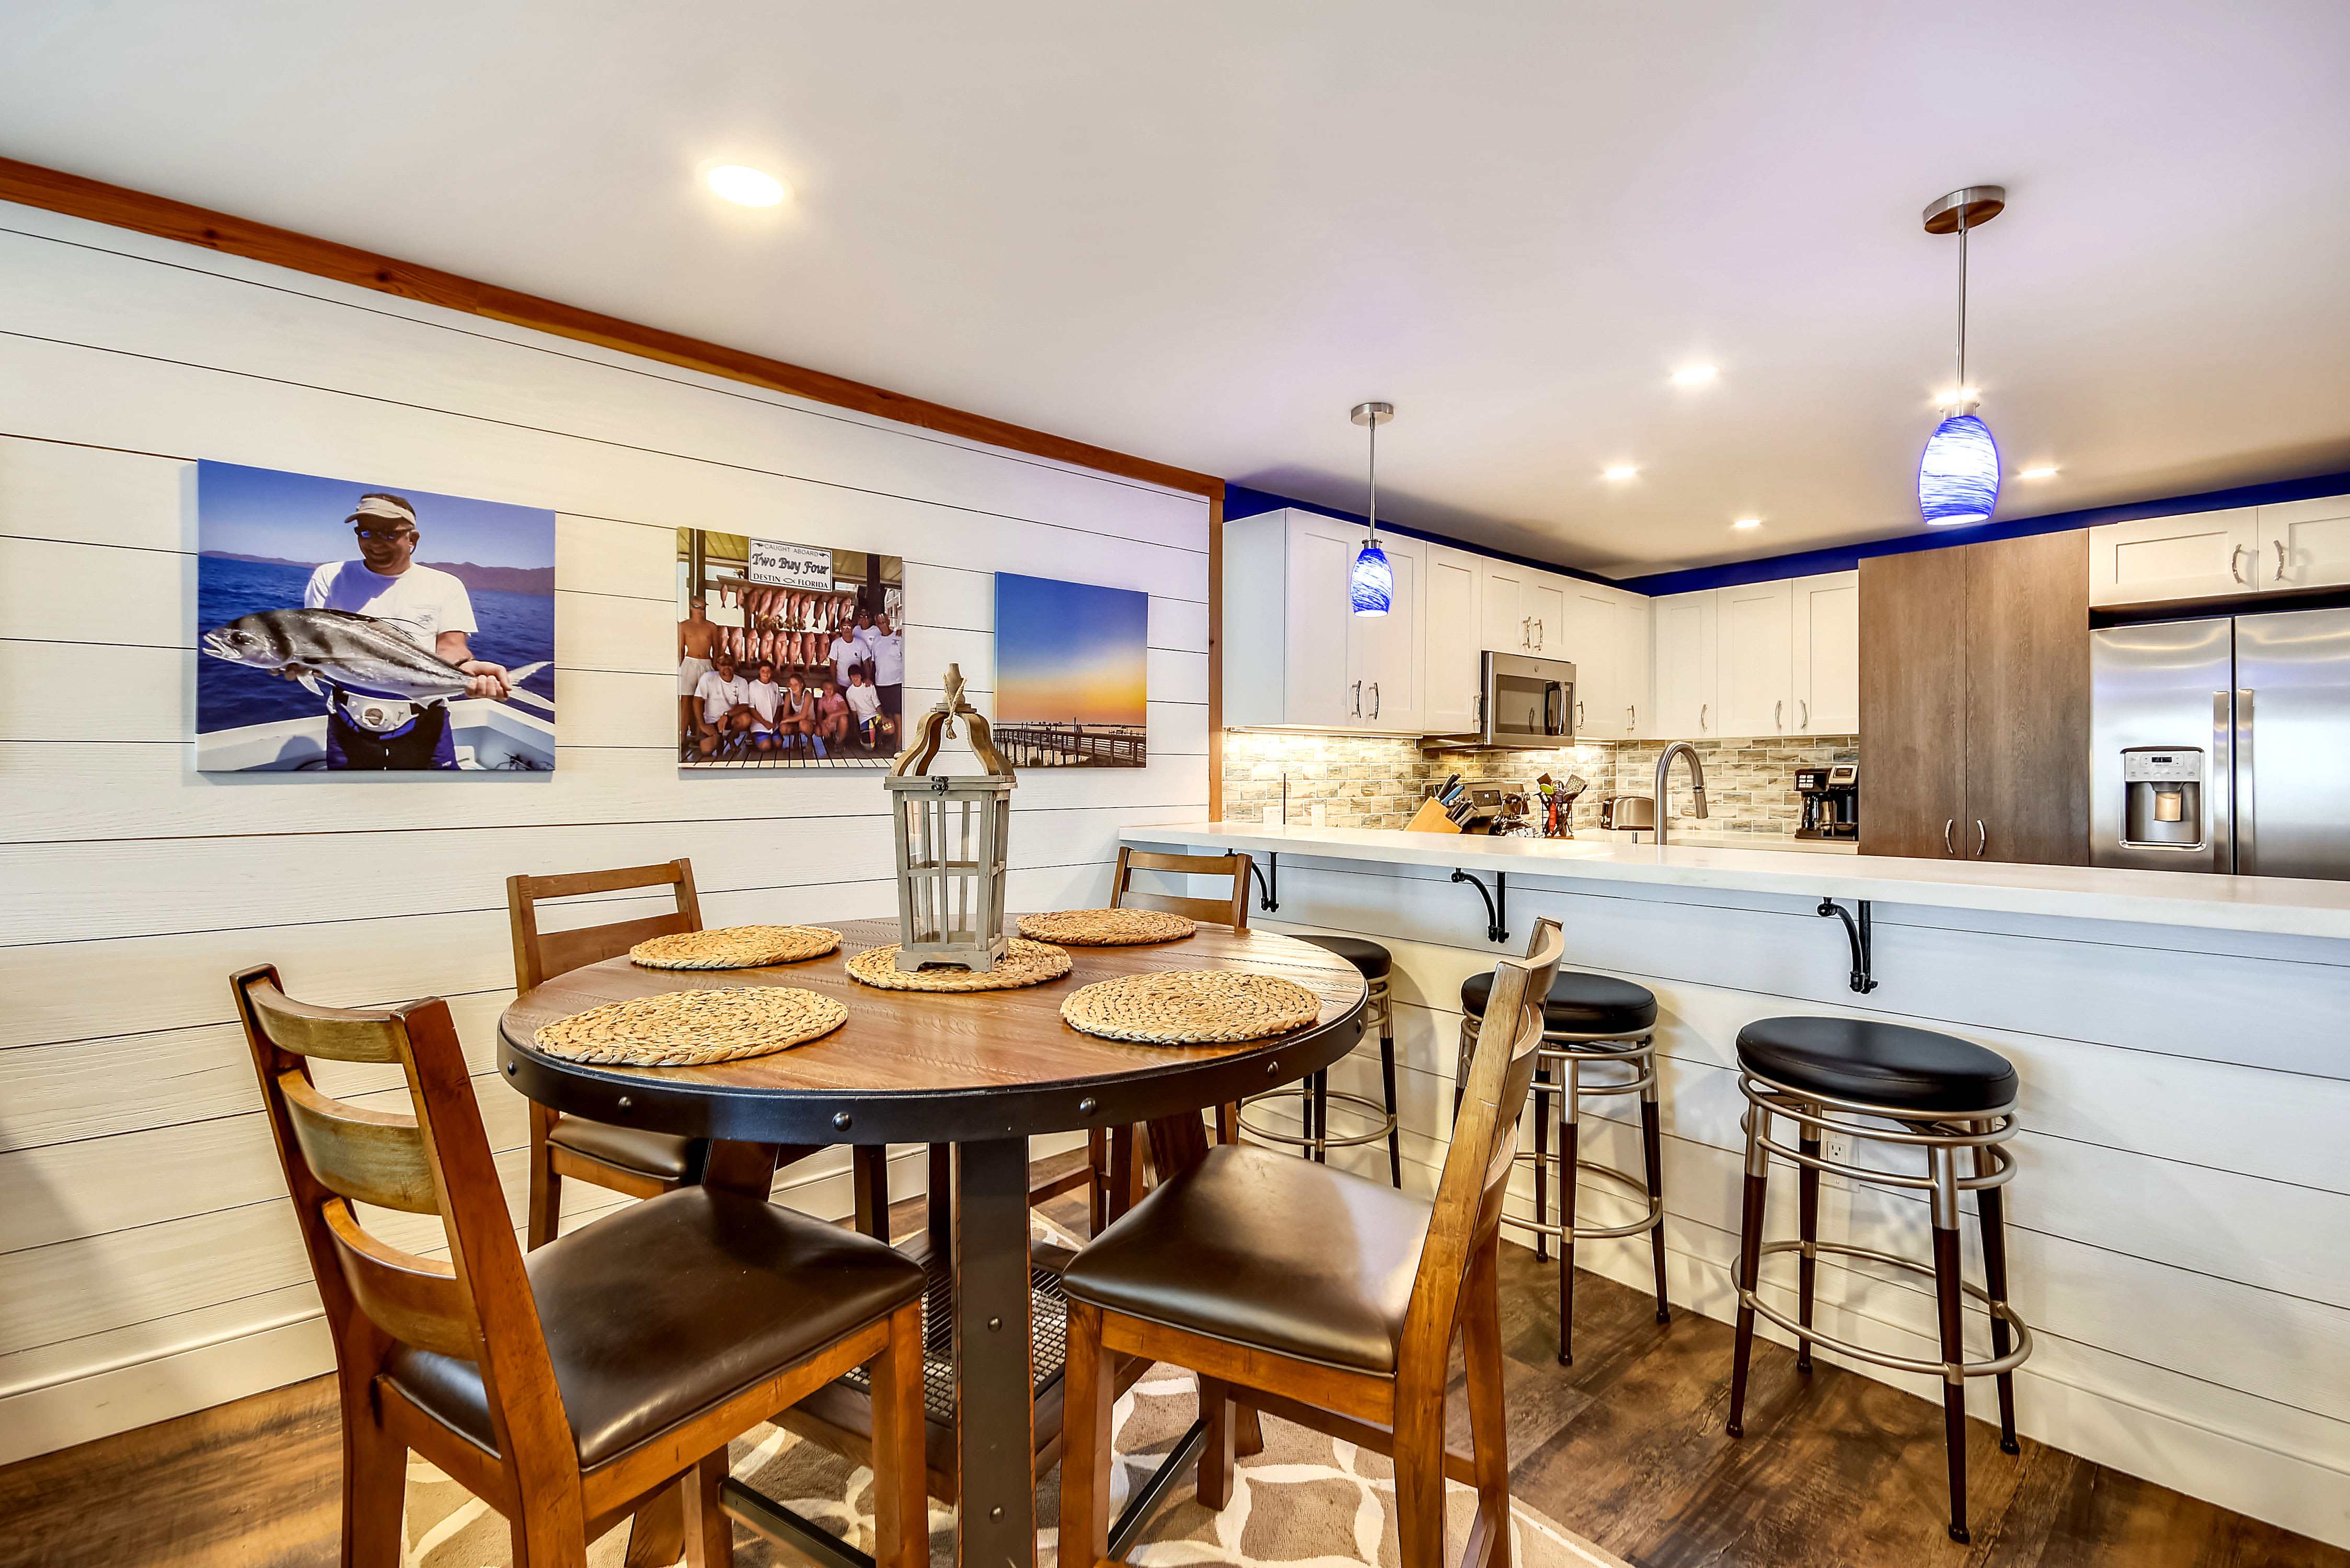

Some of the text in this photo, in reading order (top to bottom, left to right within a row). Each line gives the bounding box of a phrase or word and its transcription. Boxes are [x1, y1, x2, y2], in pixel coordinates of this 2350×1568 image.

[764, 544, 819, 557] CAUGHT ABOARD
[752, 552, 830, 575] Two Buy Four
[753, 573, 828, 589] DESTIN FLORIDA
